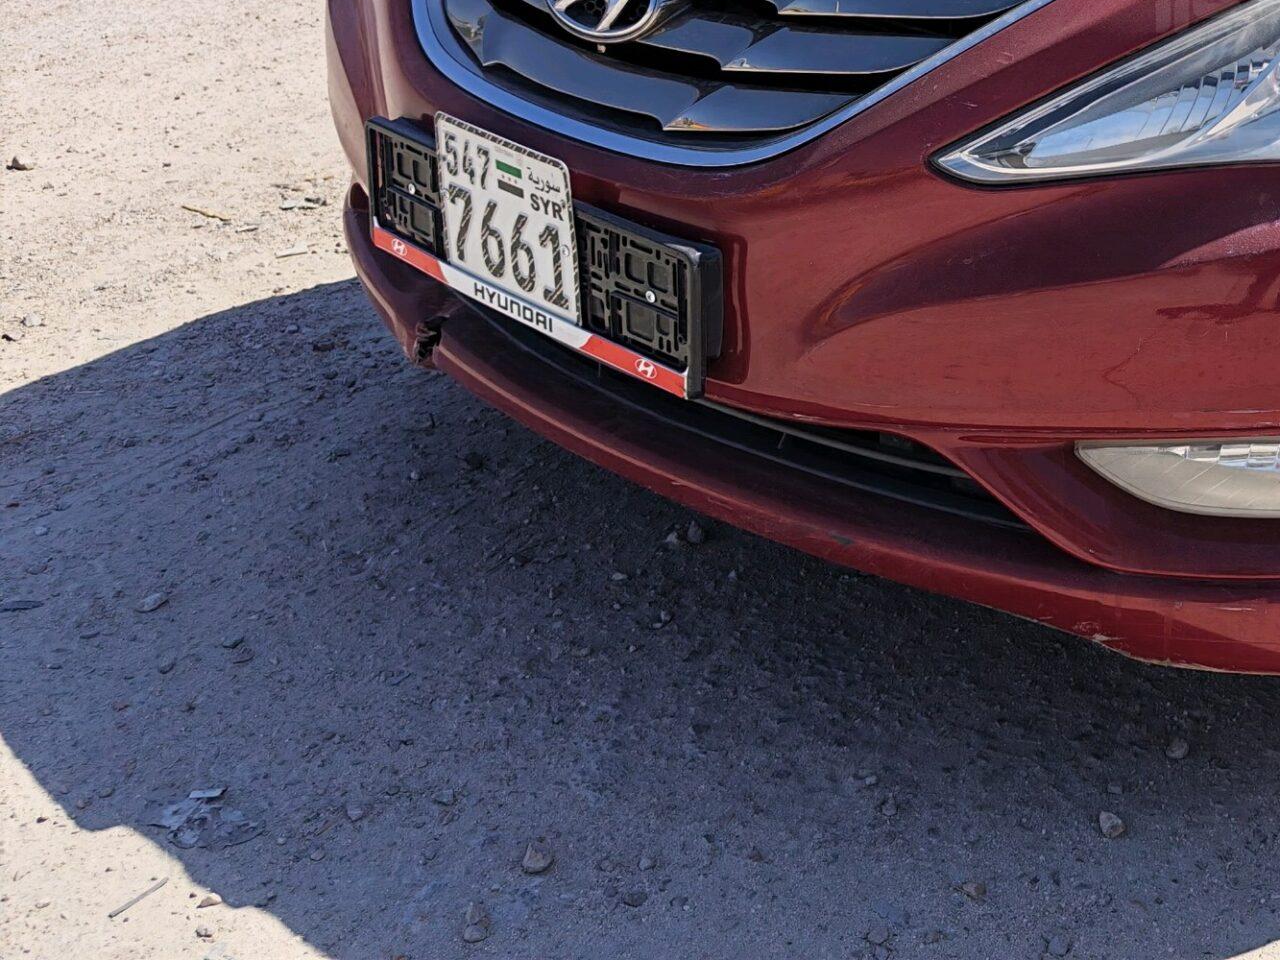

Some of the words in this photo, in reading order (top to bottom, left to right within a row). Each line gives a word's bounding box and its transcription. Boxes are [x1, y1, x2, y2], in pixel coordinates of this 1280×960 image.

[444, 130, 490, 190] 547
[526, 166, 561, 194] سورية
[530, 192, 565, 222] SYR
[448, 184, 570, 311] 7661
[474, 282, 554, 333] HYUNDAI
